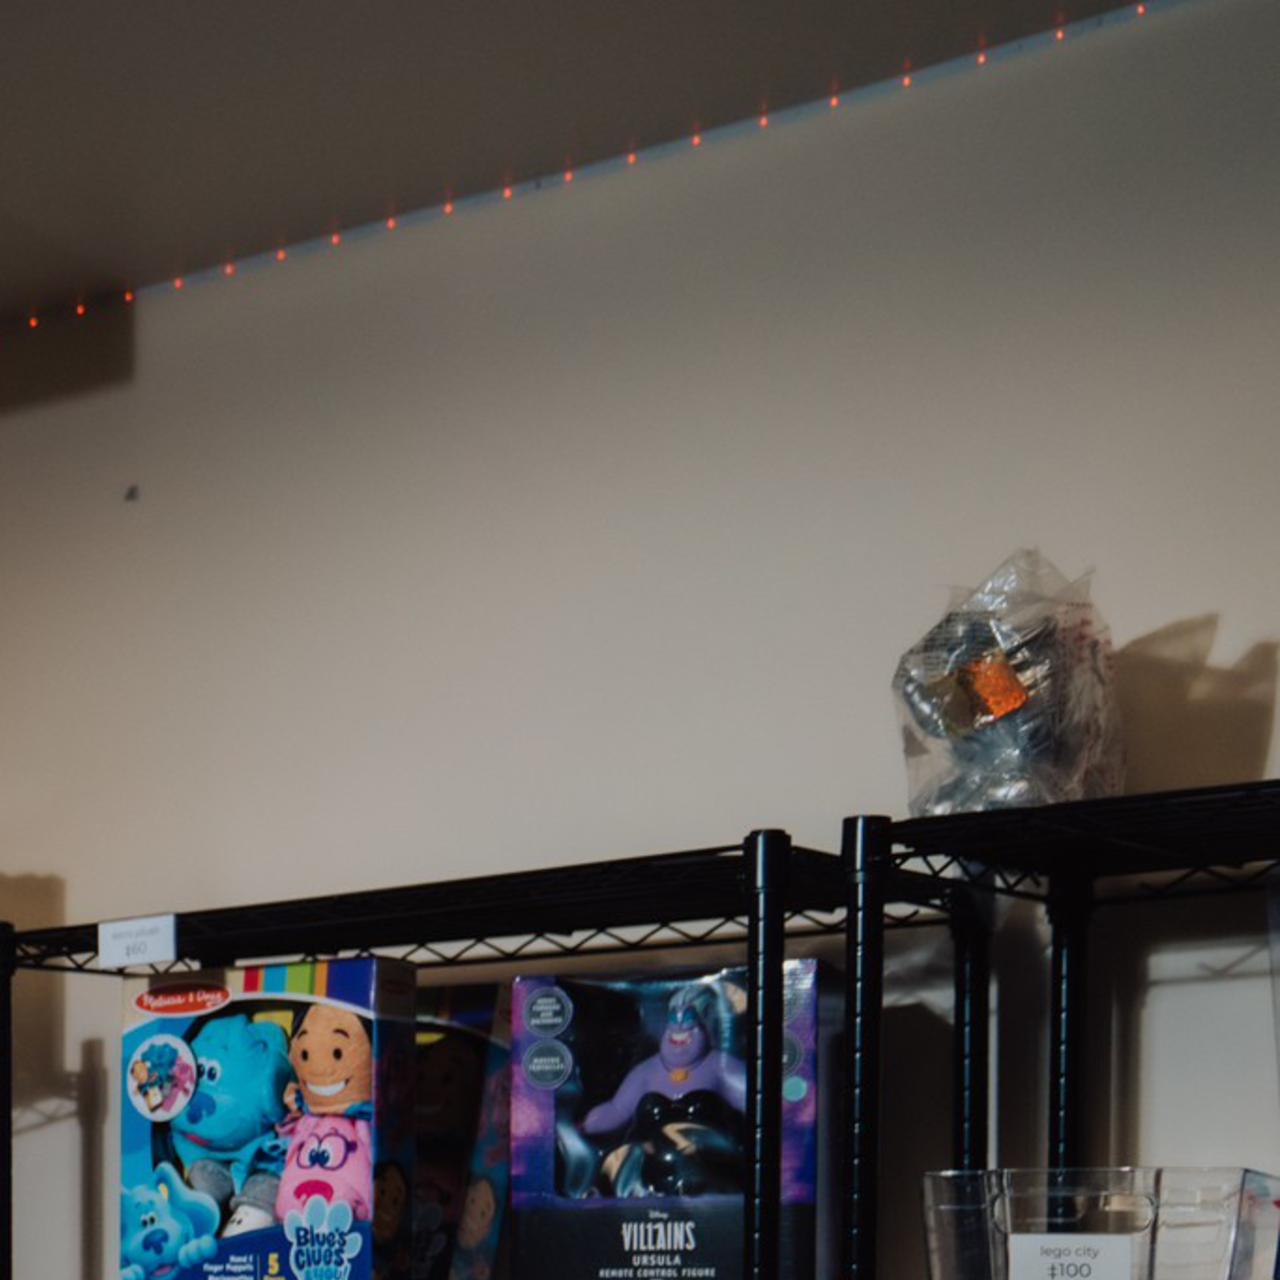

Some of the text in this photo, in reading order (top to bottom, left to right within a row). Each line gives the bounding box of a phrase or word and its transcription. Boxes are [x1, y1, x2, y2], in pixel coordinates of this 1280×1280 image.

[622, 1221, 696, 1252] VILLAINS
[631, 1254, 682, 1267] URSULA
[1040, 1244, 1101, 1261] lego city
[267, 1252, 281, 1276] 5
[598, 1267, 716, 1278] REMOTE CONTROL FIGURE
